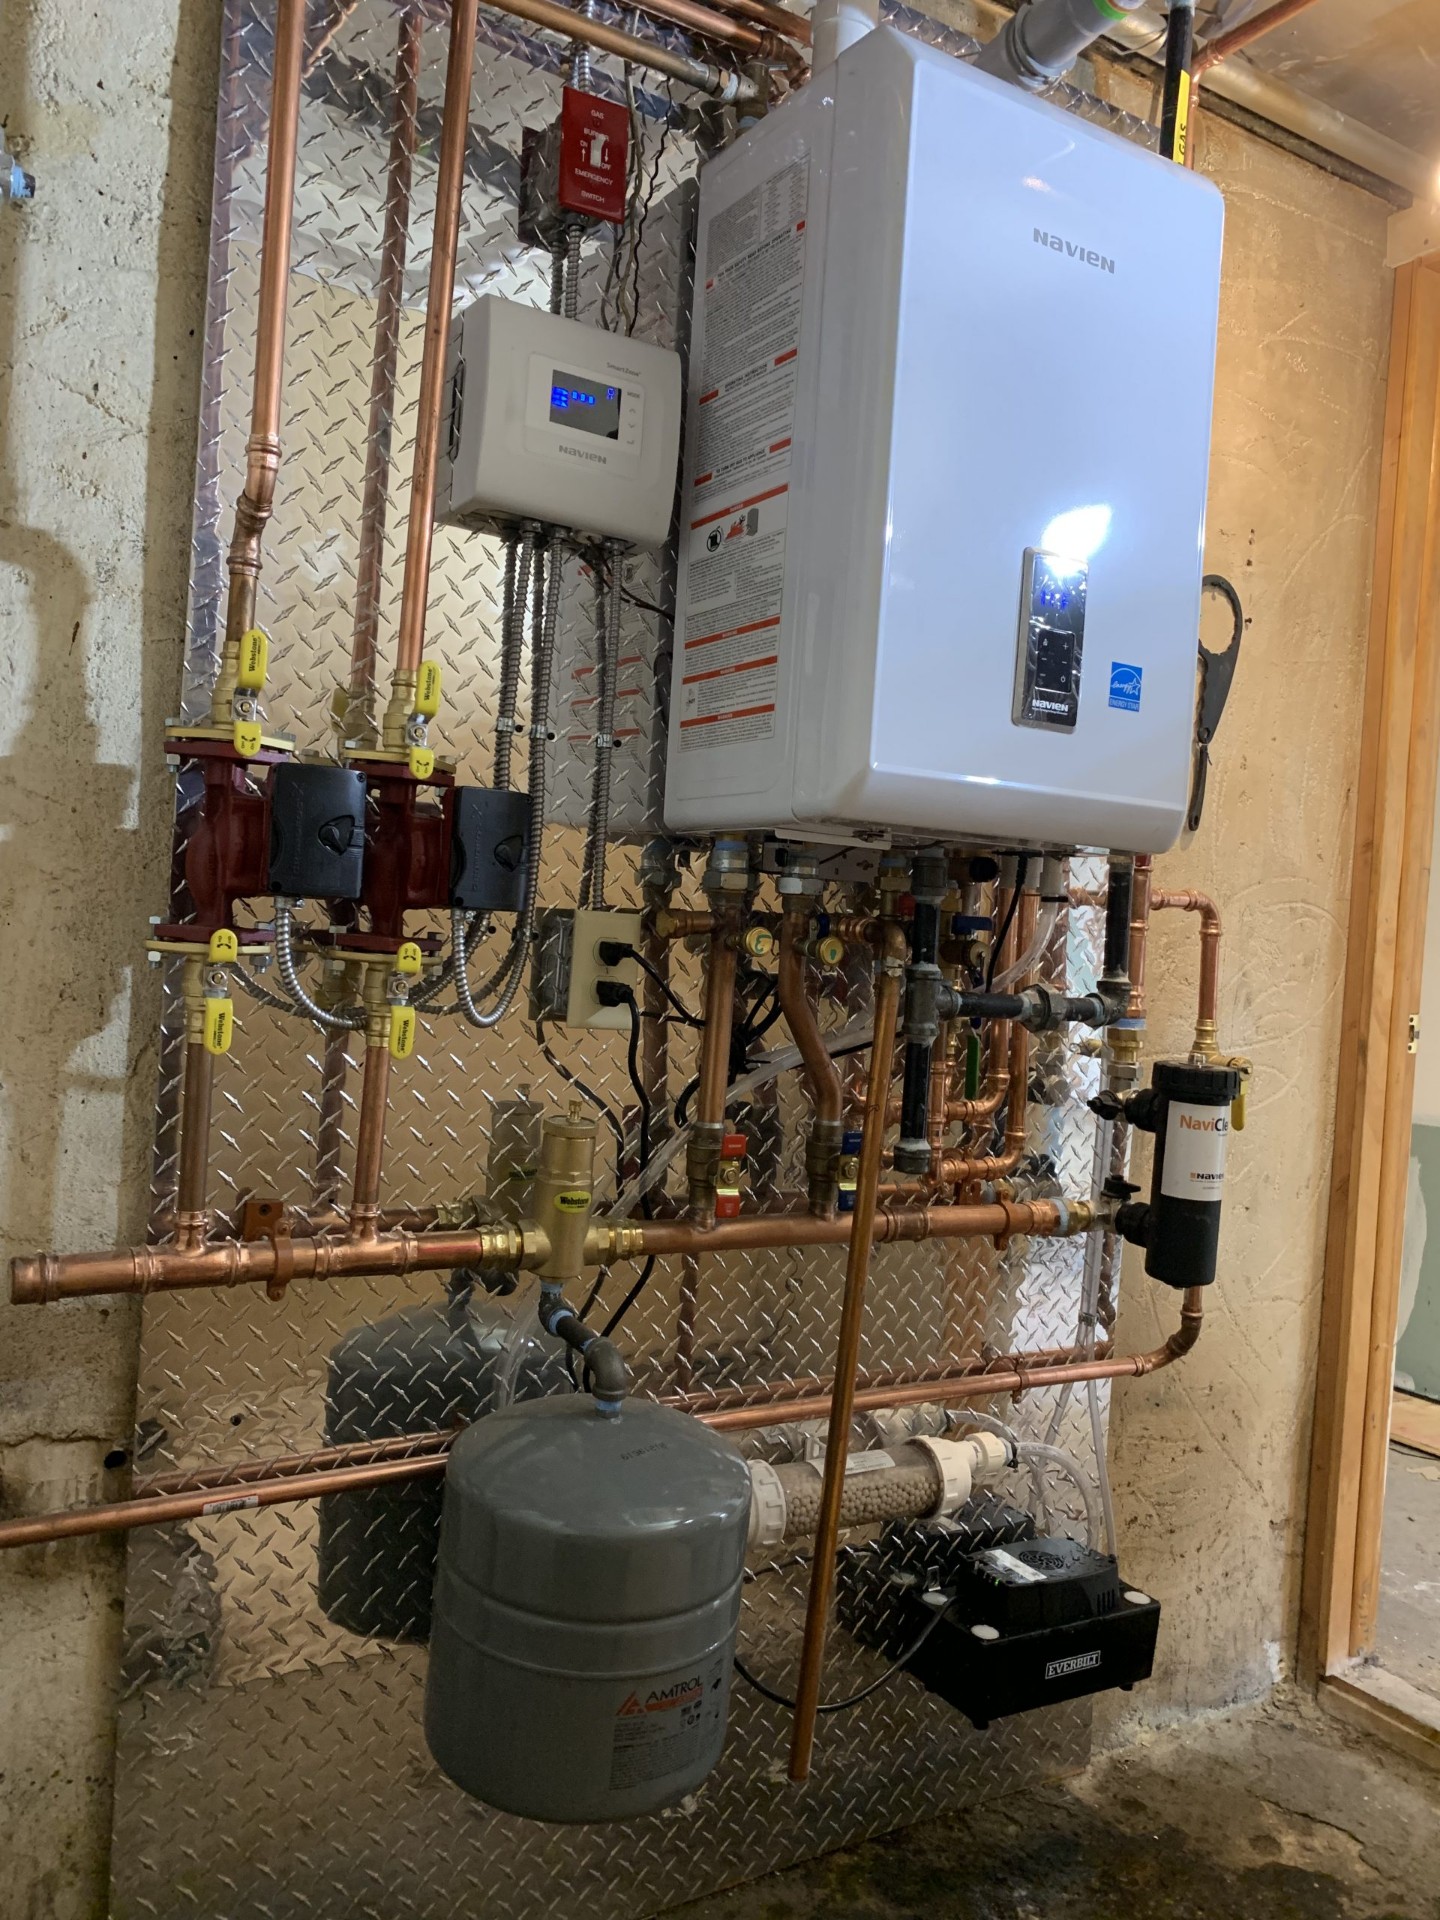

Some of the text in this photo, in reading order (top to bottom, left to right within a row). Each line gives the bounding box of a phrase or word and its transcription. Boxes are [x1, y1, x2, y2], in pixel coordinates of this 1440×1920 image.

[591, 109, 604, 120] GAS
[574, 167, 613, 186] EMERGENCY
[581, 190, 605, 204] SWITCH
[1033, 227, 1115, 275] Navien
[559, 445, 607, 465] Navien
[1031, 699, 1069, 712] Navien
[1180, 1114, 1228, 1132] NaviCle
[1196, 1172, 1224, 1180] Navie
[1048, 1654, 1099, 1676] EVERBILT
[646, 1675, 703, 1703] AMTROL
